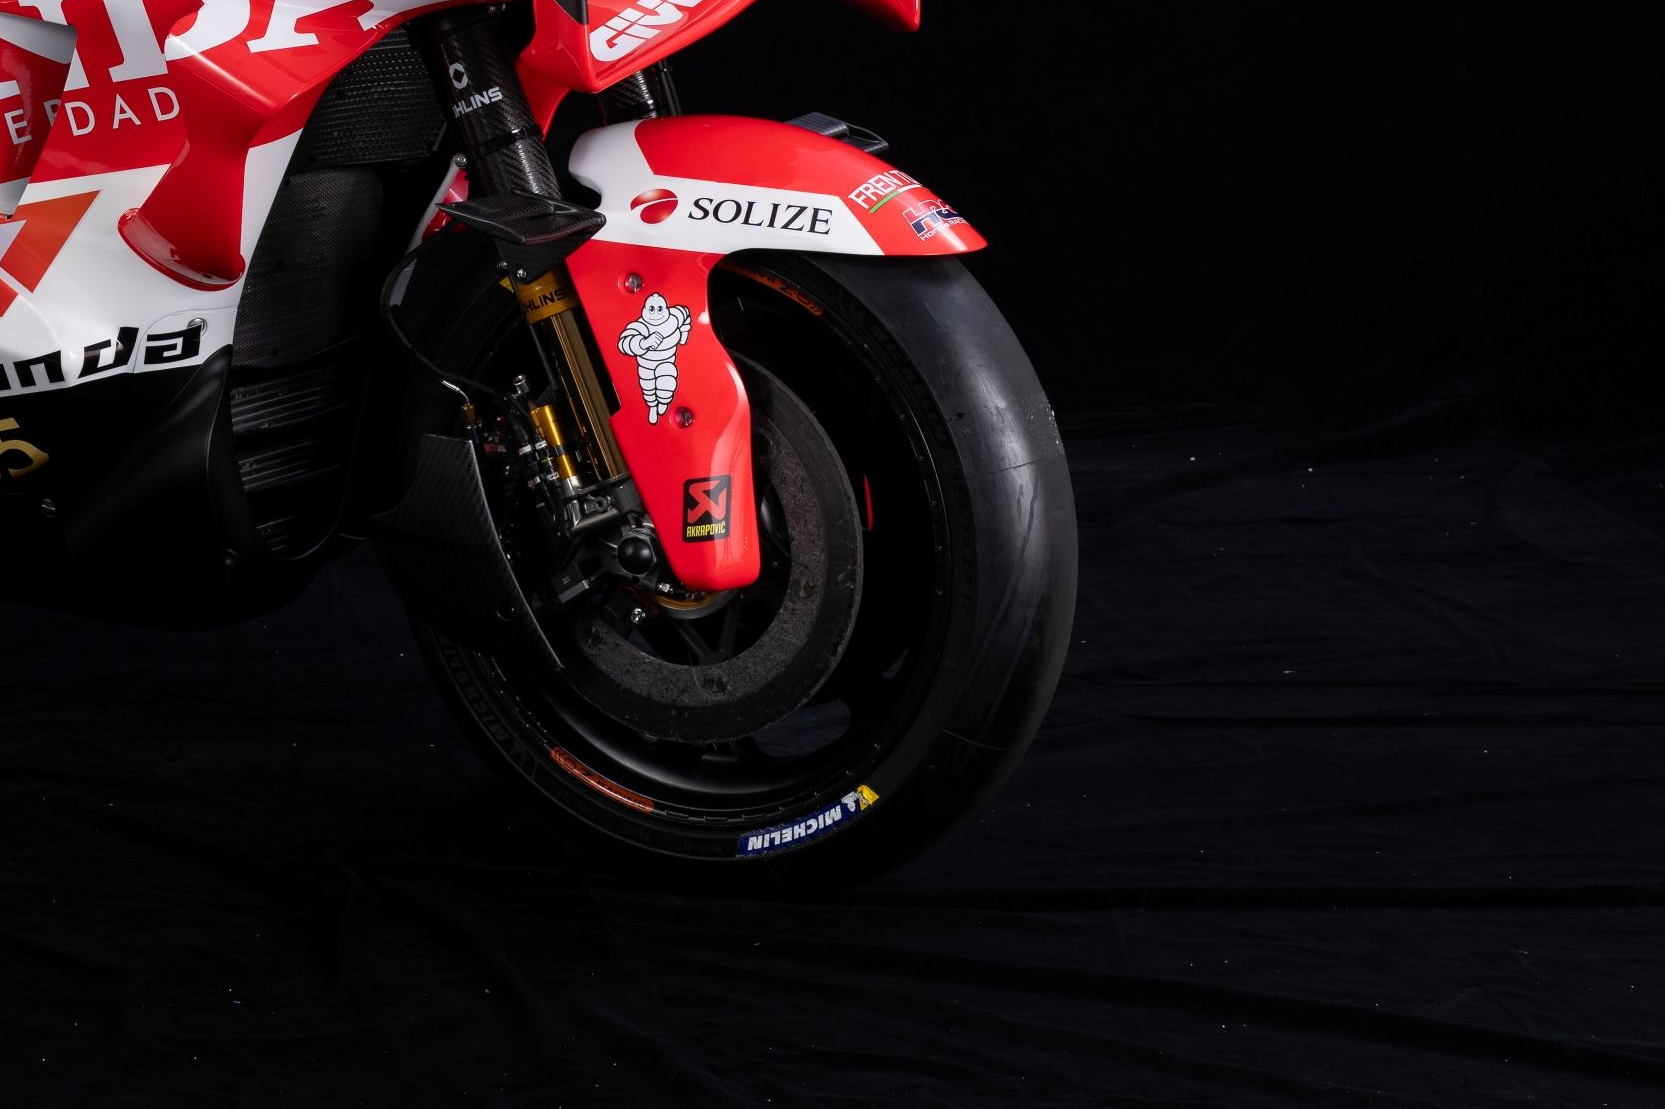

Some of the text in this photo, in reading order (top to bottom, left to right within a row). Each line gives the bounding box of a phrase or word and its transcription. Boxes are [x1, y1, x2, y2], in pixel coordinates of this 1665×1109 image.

[450, 85, 503, 120] HLINS
[687, 196, 833, 235] SOLIZE
[525, 290, 568, 311] HLINS
[747, 804, 843, 851] MICHELIN
